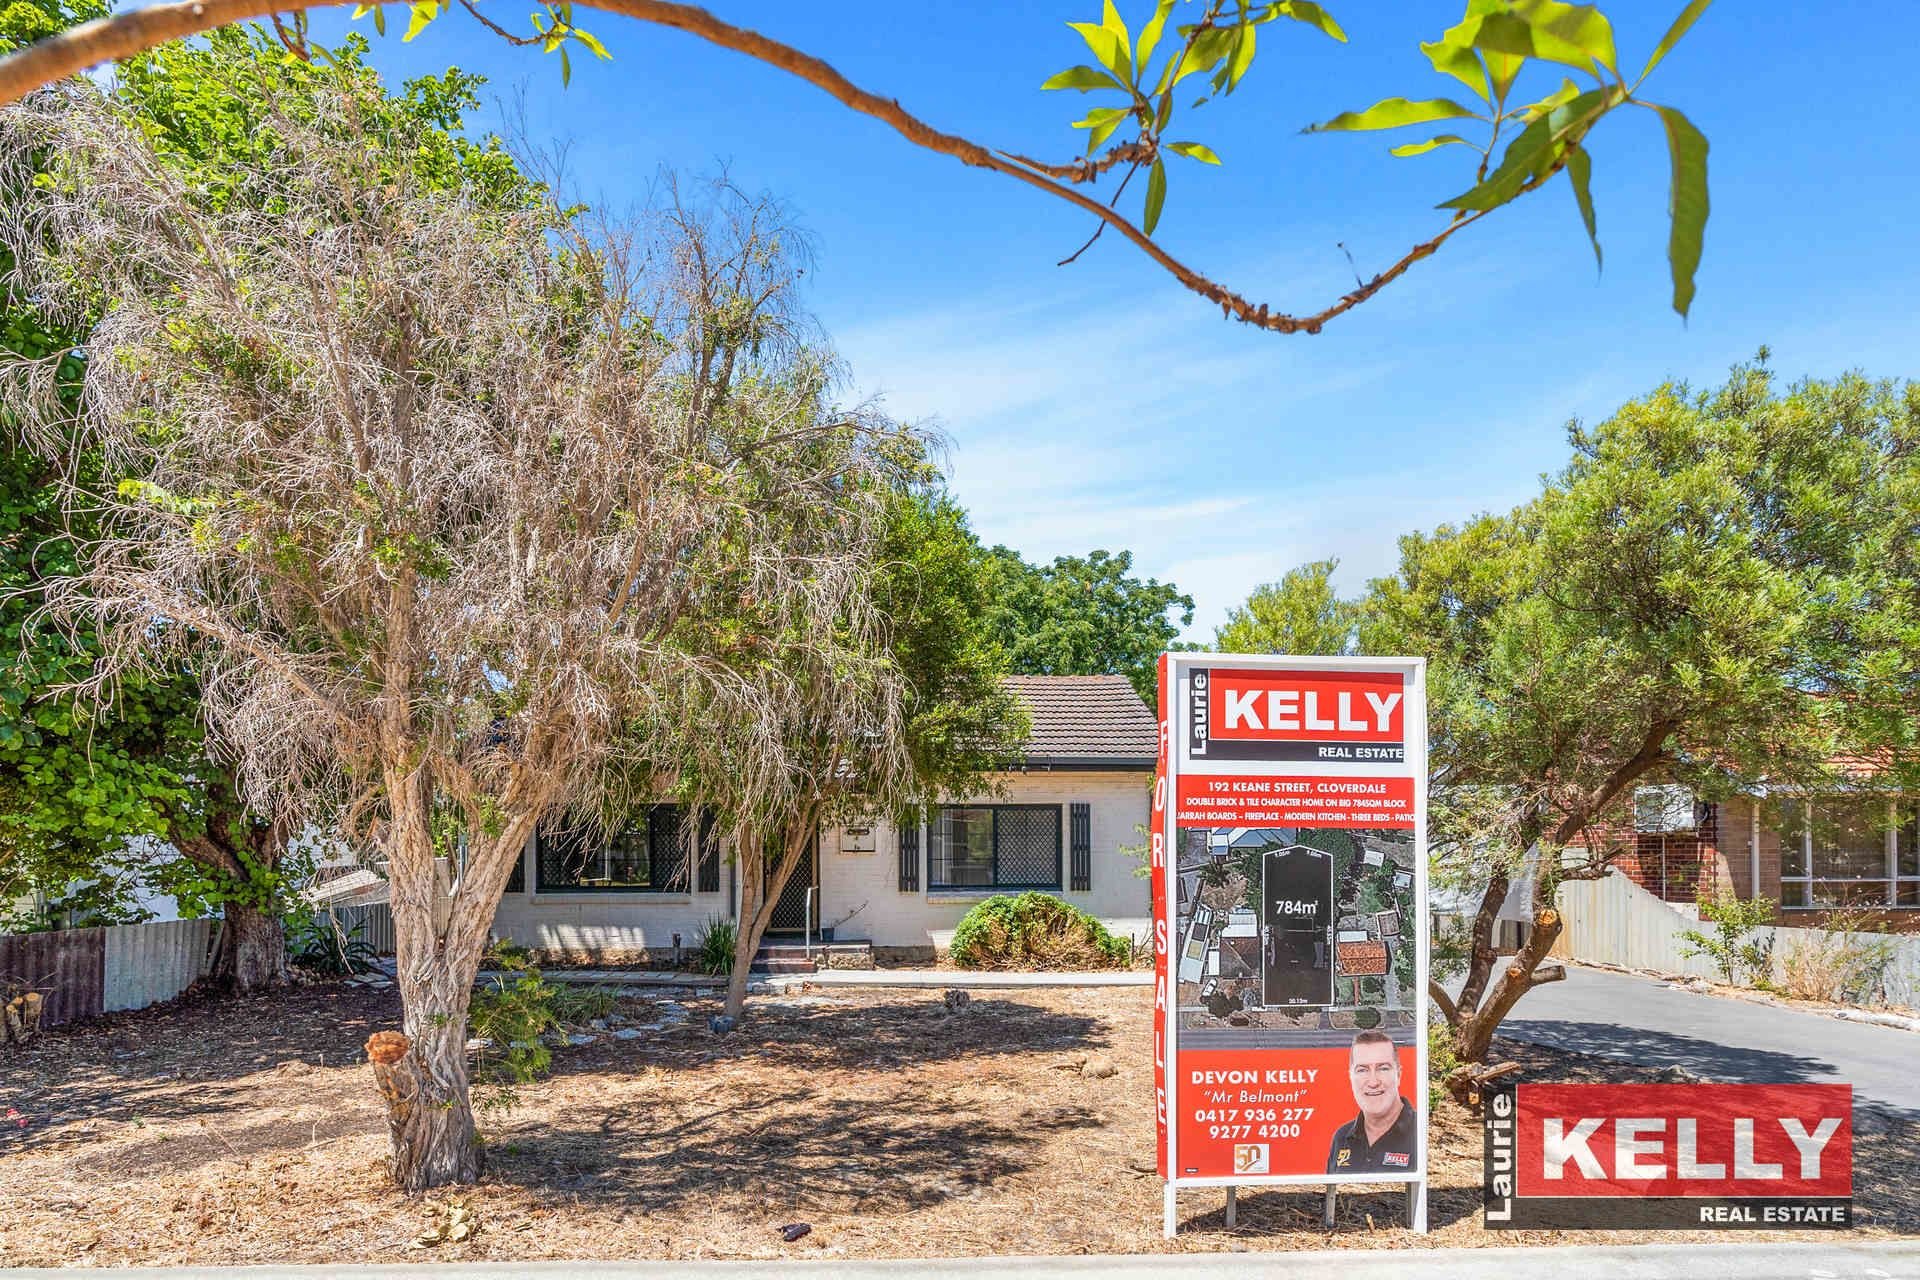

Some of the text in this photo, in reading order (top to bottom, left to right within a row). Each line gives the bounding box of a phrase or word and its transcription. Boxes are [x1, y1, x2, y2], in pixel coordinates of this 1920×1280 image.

[1191, 674, 1208, 755] Laurie
[1224, 689, 1403, 732] KELLY
[1318, 747, 1404, 759] REAL ESTATE
[1208, 782, 1387, 794] 192 KEANE STREET, CLOVERDALE
[1186, 798, 1215, 806] DOUBLE
[1216, 798, 1237, 806] BRICK
[1246, 798, 1259, 806] TILE
[1260, 798, 1301, 807] CHARACTER
[1302, 798, 1324, 807] HOME
[1325, 799, 1337, 807] ON
[1383, 799, 1407, 808] BLOCK
[1206, 812, 1237, 820] BOARDS
[1244, 812, 1279, 820] FIREPLACE
[1284, 812, 1316, 821] MODERN
[1317, 813, 1346, 821] KITCHEN
[1352, 813, 1372, 821] THREE
[1373, 813, 1390, 821] BEDS
[1152, 720, 1168, 1125] FOR SALE
[1191, 1070, 1319, 1084] DEVON KELLY
[1195, 1108, 1314, 1122] 0417 936 277
[1209, 1124, 1300, 1139] 9277 4200
